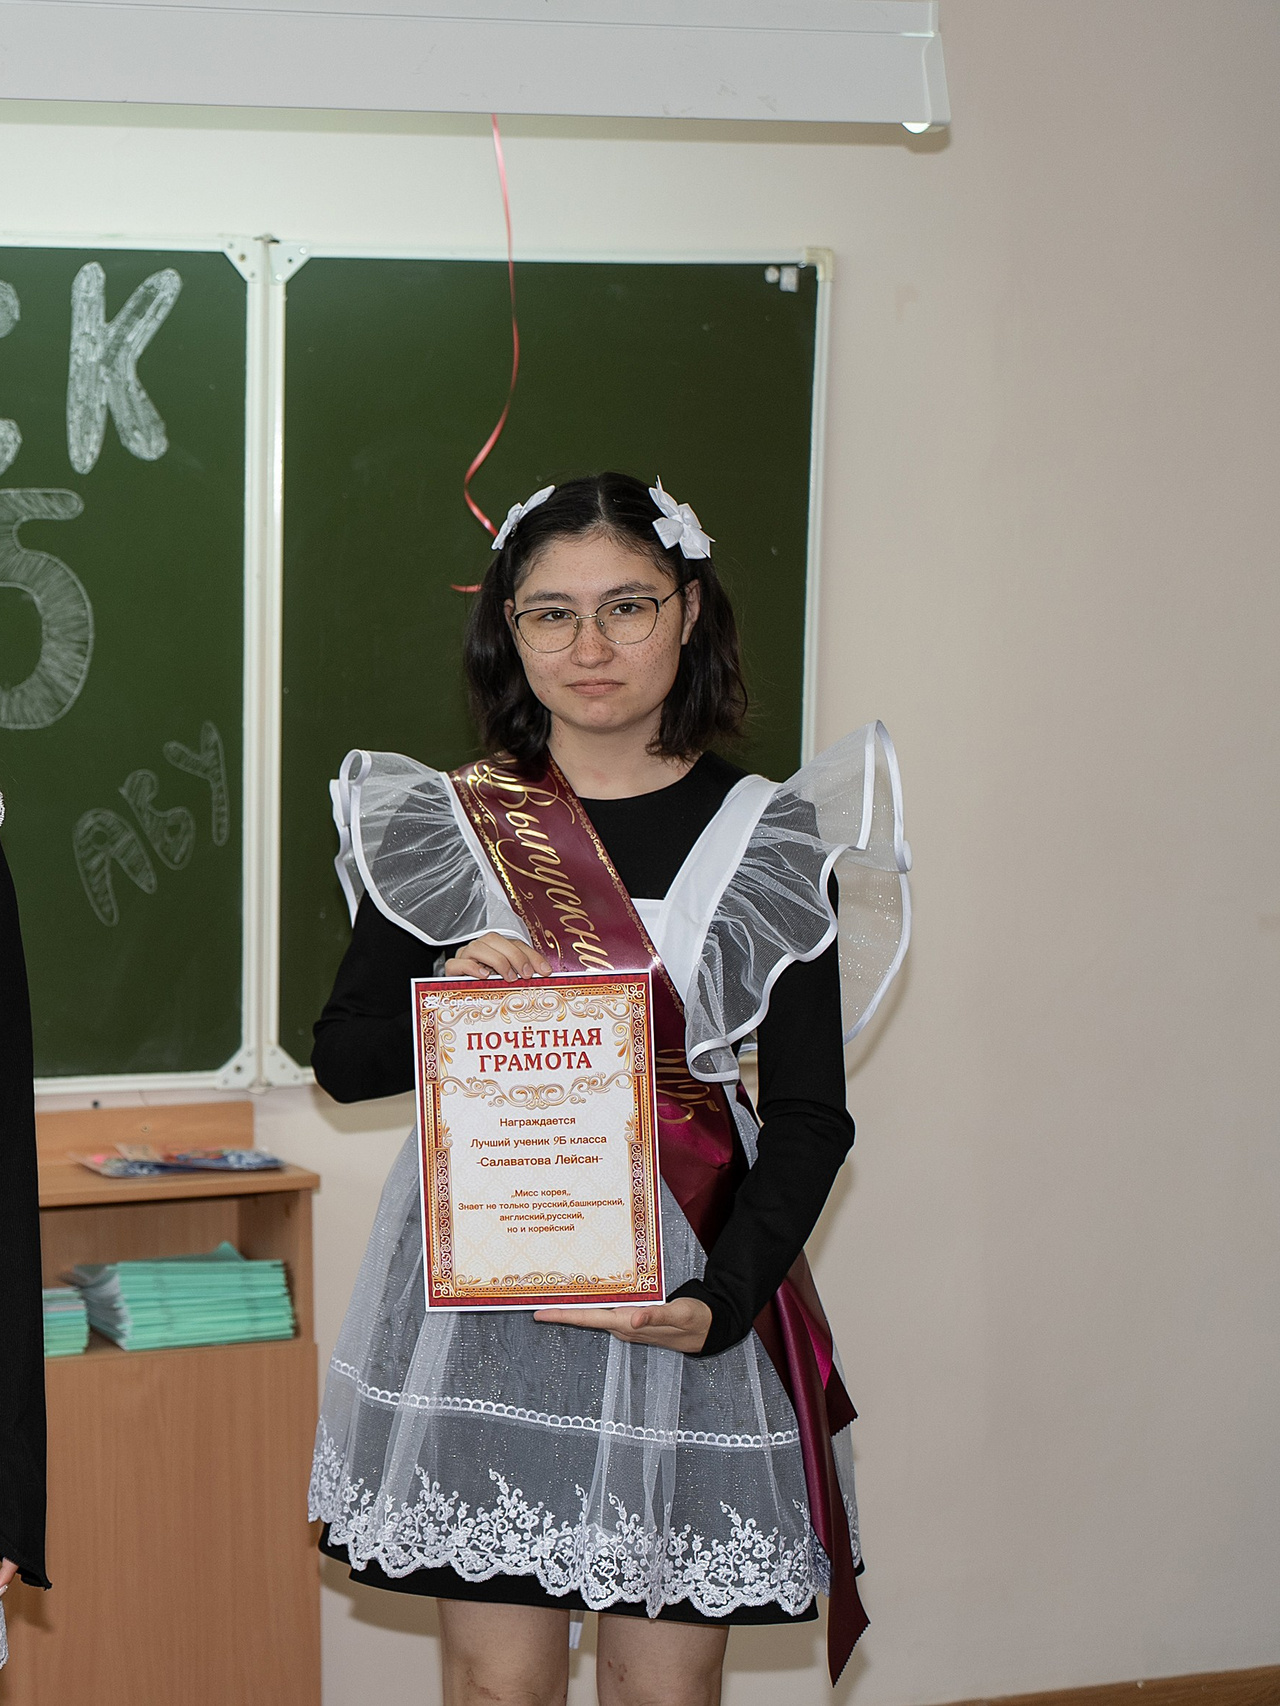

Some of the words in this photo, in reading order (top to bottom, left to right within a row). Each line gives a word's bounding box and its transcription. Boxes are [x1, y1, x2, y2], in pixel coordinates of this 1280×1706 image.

[466, 1026, 603, 1050] ПОЧЁТНАЯ
[479, 1051, 593, 1073] ГРАМОТА
[499, 1117, 577, 1129] Награждается
[470, 1138, 511, 1149] Лучший
[513, 1138, 550, 1148] ученик
[553, 1136, 567, 1145] 9Б
[570, 1135, 608, 1145] класса
[476, 1156, 552, 1168] -Салаватова
[554, 1153, 604, 1165] Лейсан-
[458, 1203, 484, 1211] Знает
[499, 1201, 530, 1210] только
[528, 1223, 575, 1234] корейский
